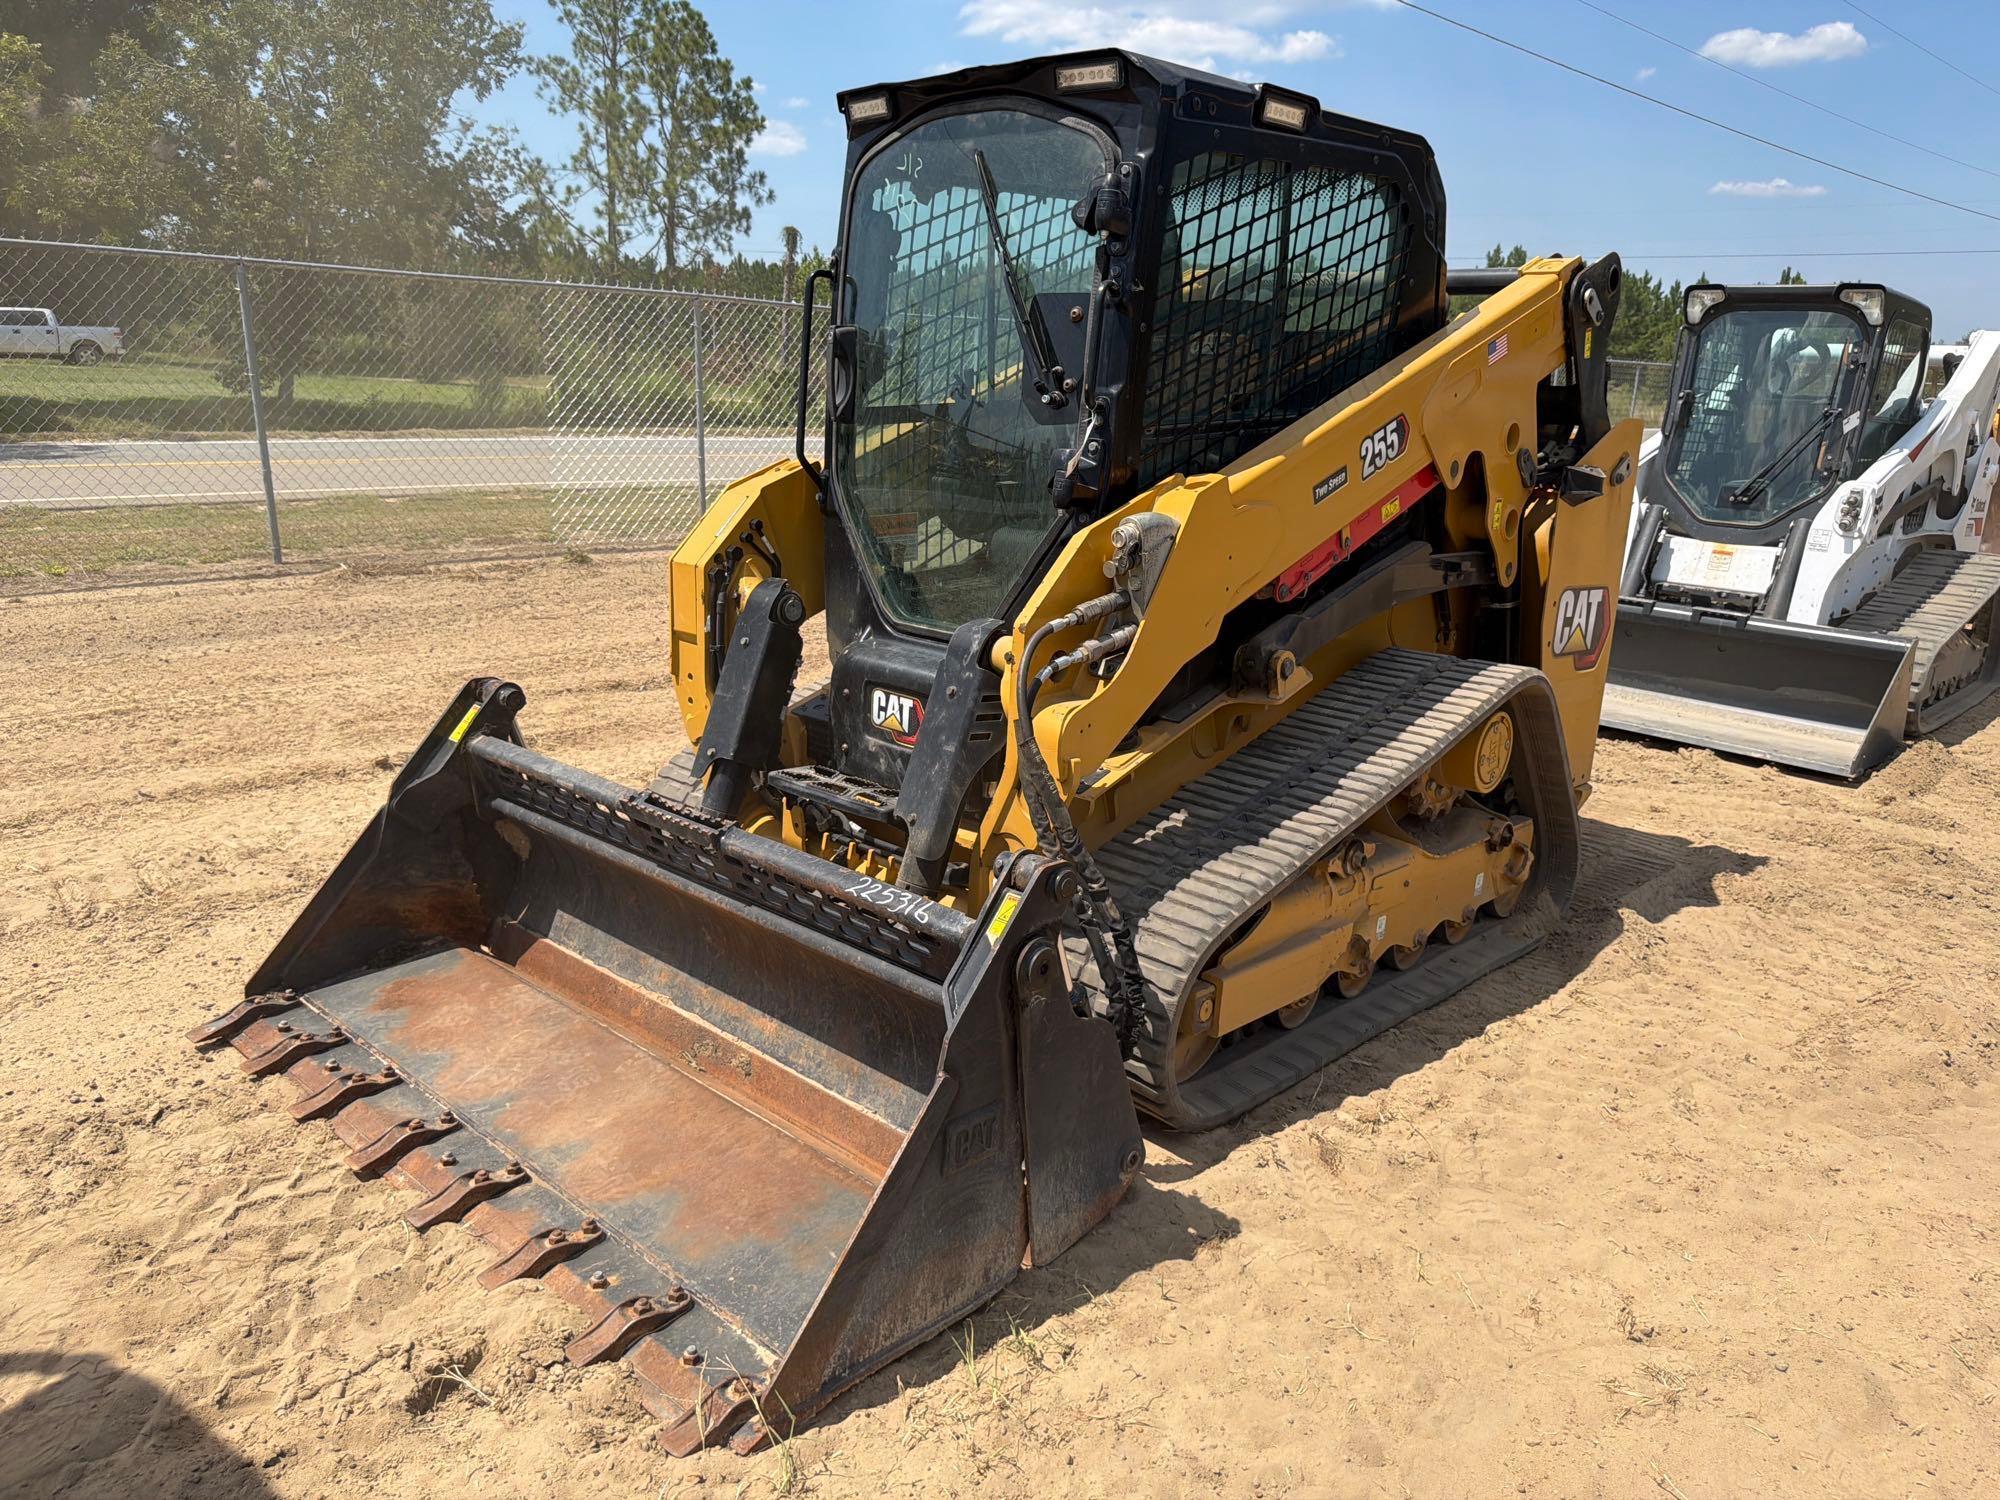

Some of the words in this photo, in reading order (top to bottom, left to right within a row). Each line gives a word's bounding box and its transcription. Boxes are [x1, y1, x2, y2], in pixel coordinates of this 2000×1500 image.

[1361, 419, 1399, 479] 255
[1553, 589, 1604, 654] CAT
[872, 690, 914, 733] CAT
[845, 877, 929, 923] 225316
[955, 1116, 997, 1164] CAT
